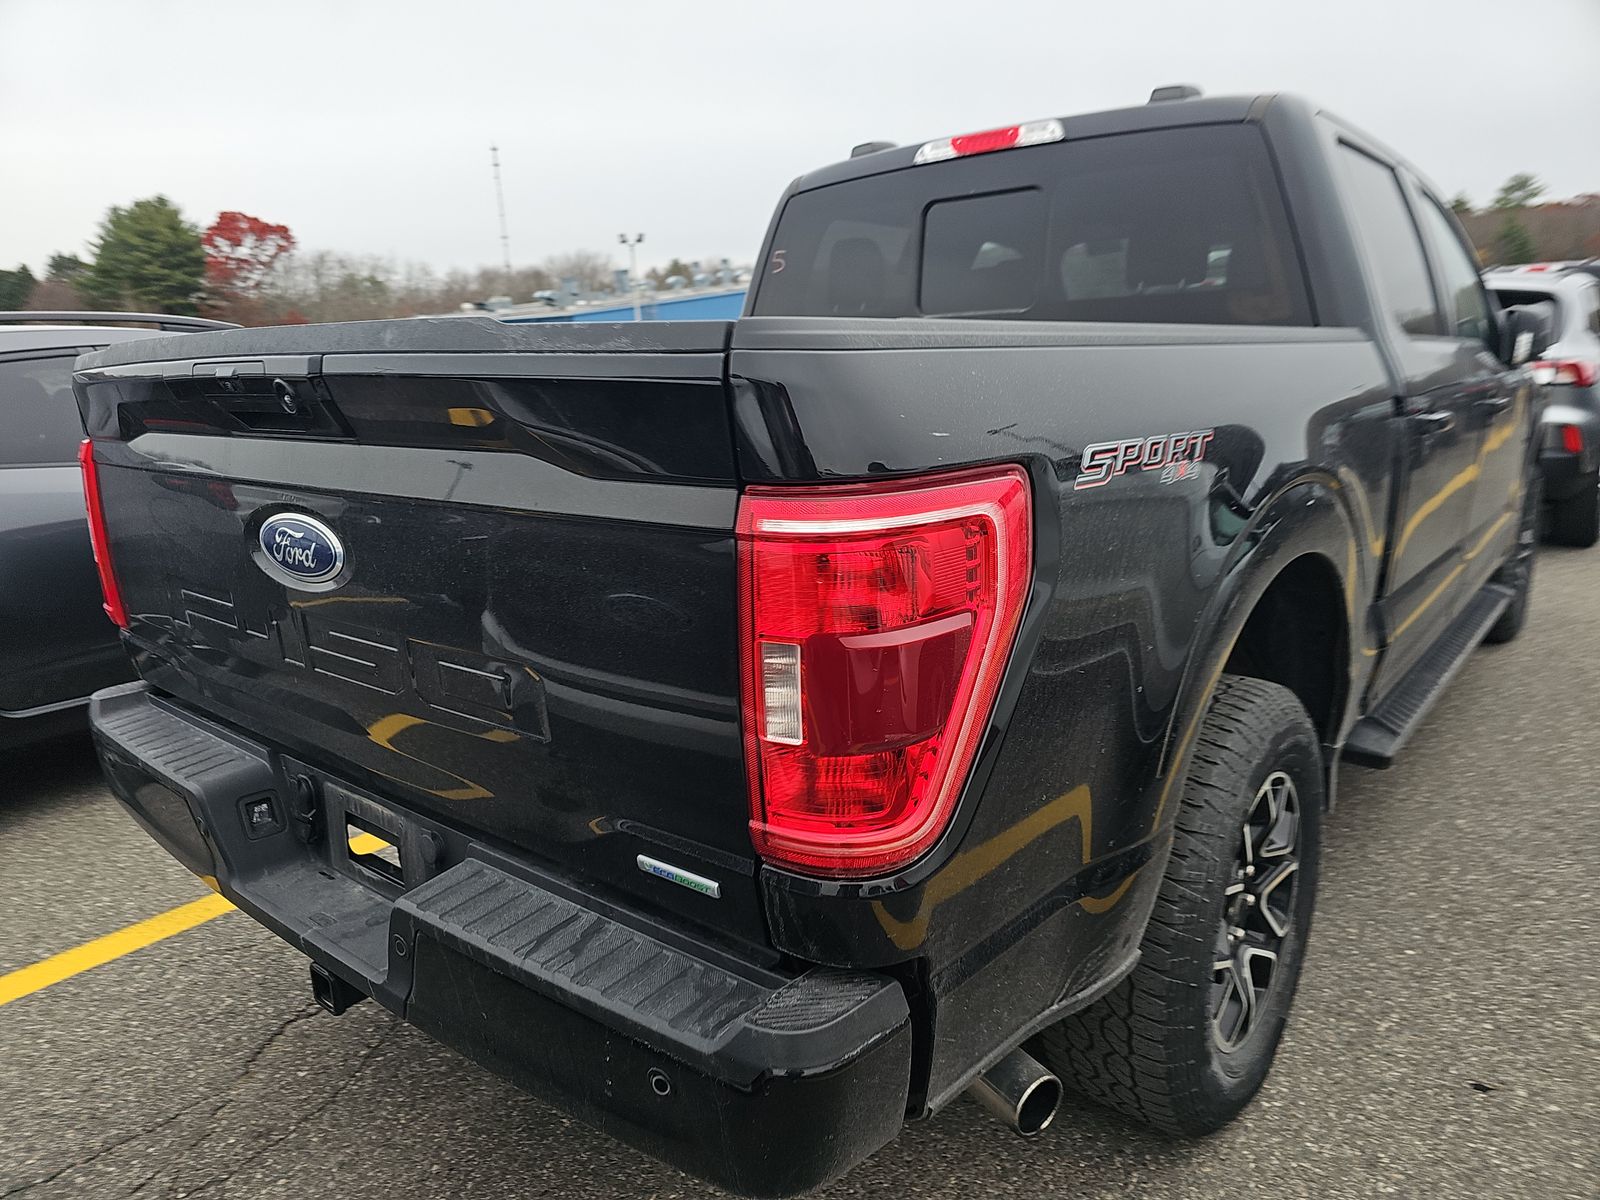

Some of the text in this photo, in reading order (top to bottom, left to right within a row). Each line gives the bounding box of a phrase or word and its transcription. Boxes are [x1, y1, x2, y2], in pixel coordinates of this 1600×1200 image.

[772, 249, 787, 274] 5
[1074, 429, 1215, 490] SPORT
[273, 526, 317, 568] Ford
